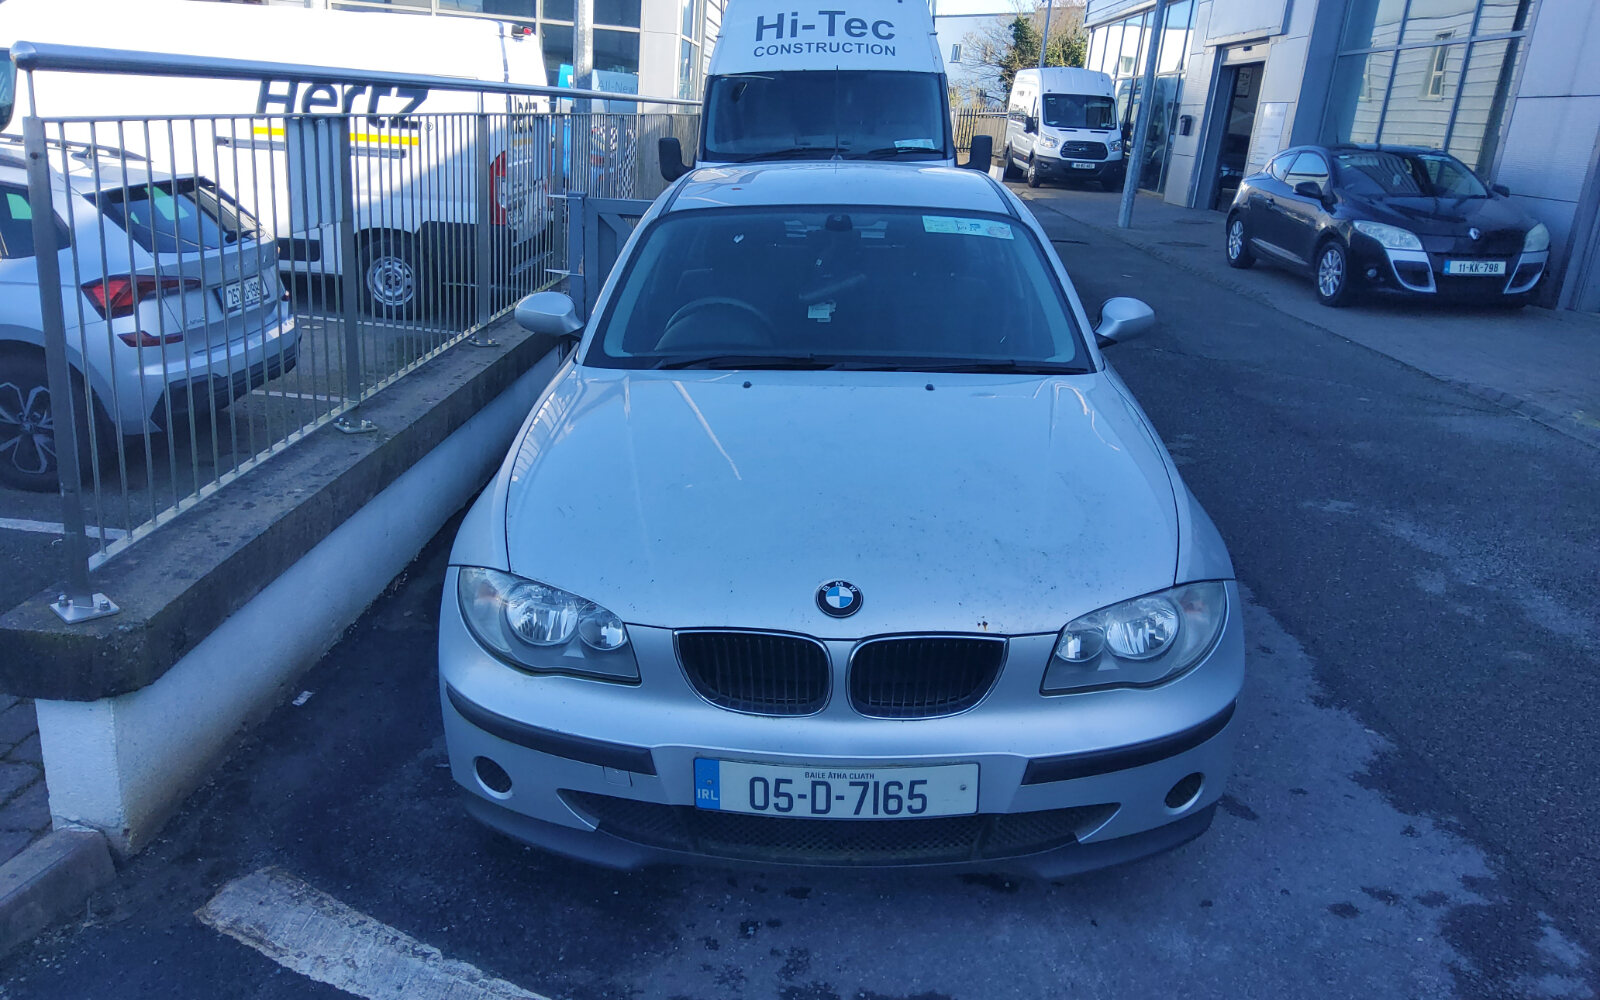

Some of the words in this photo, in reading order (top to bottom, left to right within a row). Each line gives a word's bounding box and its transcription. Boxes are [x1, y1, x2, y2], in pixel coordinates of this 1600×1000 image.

[756, 10, 896, 42] Hi-Tec
[753, 42, 896, 58] CONSTRUCTION
[256, 79, 428, 130] Hertz
[1459, 263, 1499, 273] 11-KK-798
[822, 581, 858, 592] BMW
[804, 771, 826, 779] BAILE
[849, 772, 875, 780] CLIATH
[696, 788, 719, 801] IRL
[749, 776, 928, 816] 05-D-7165
